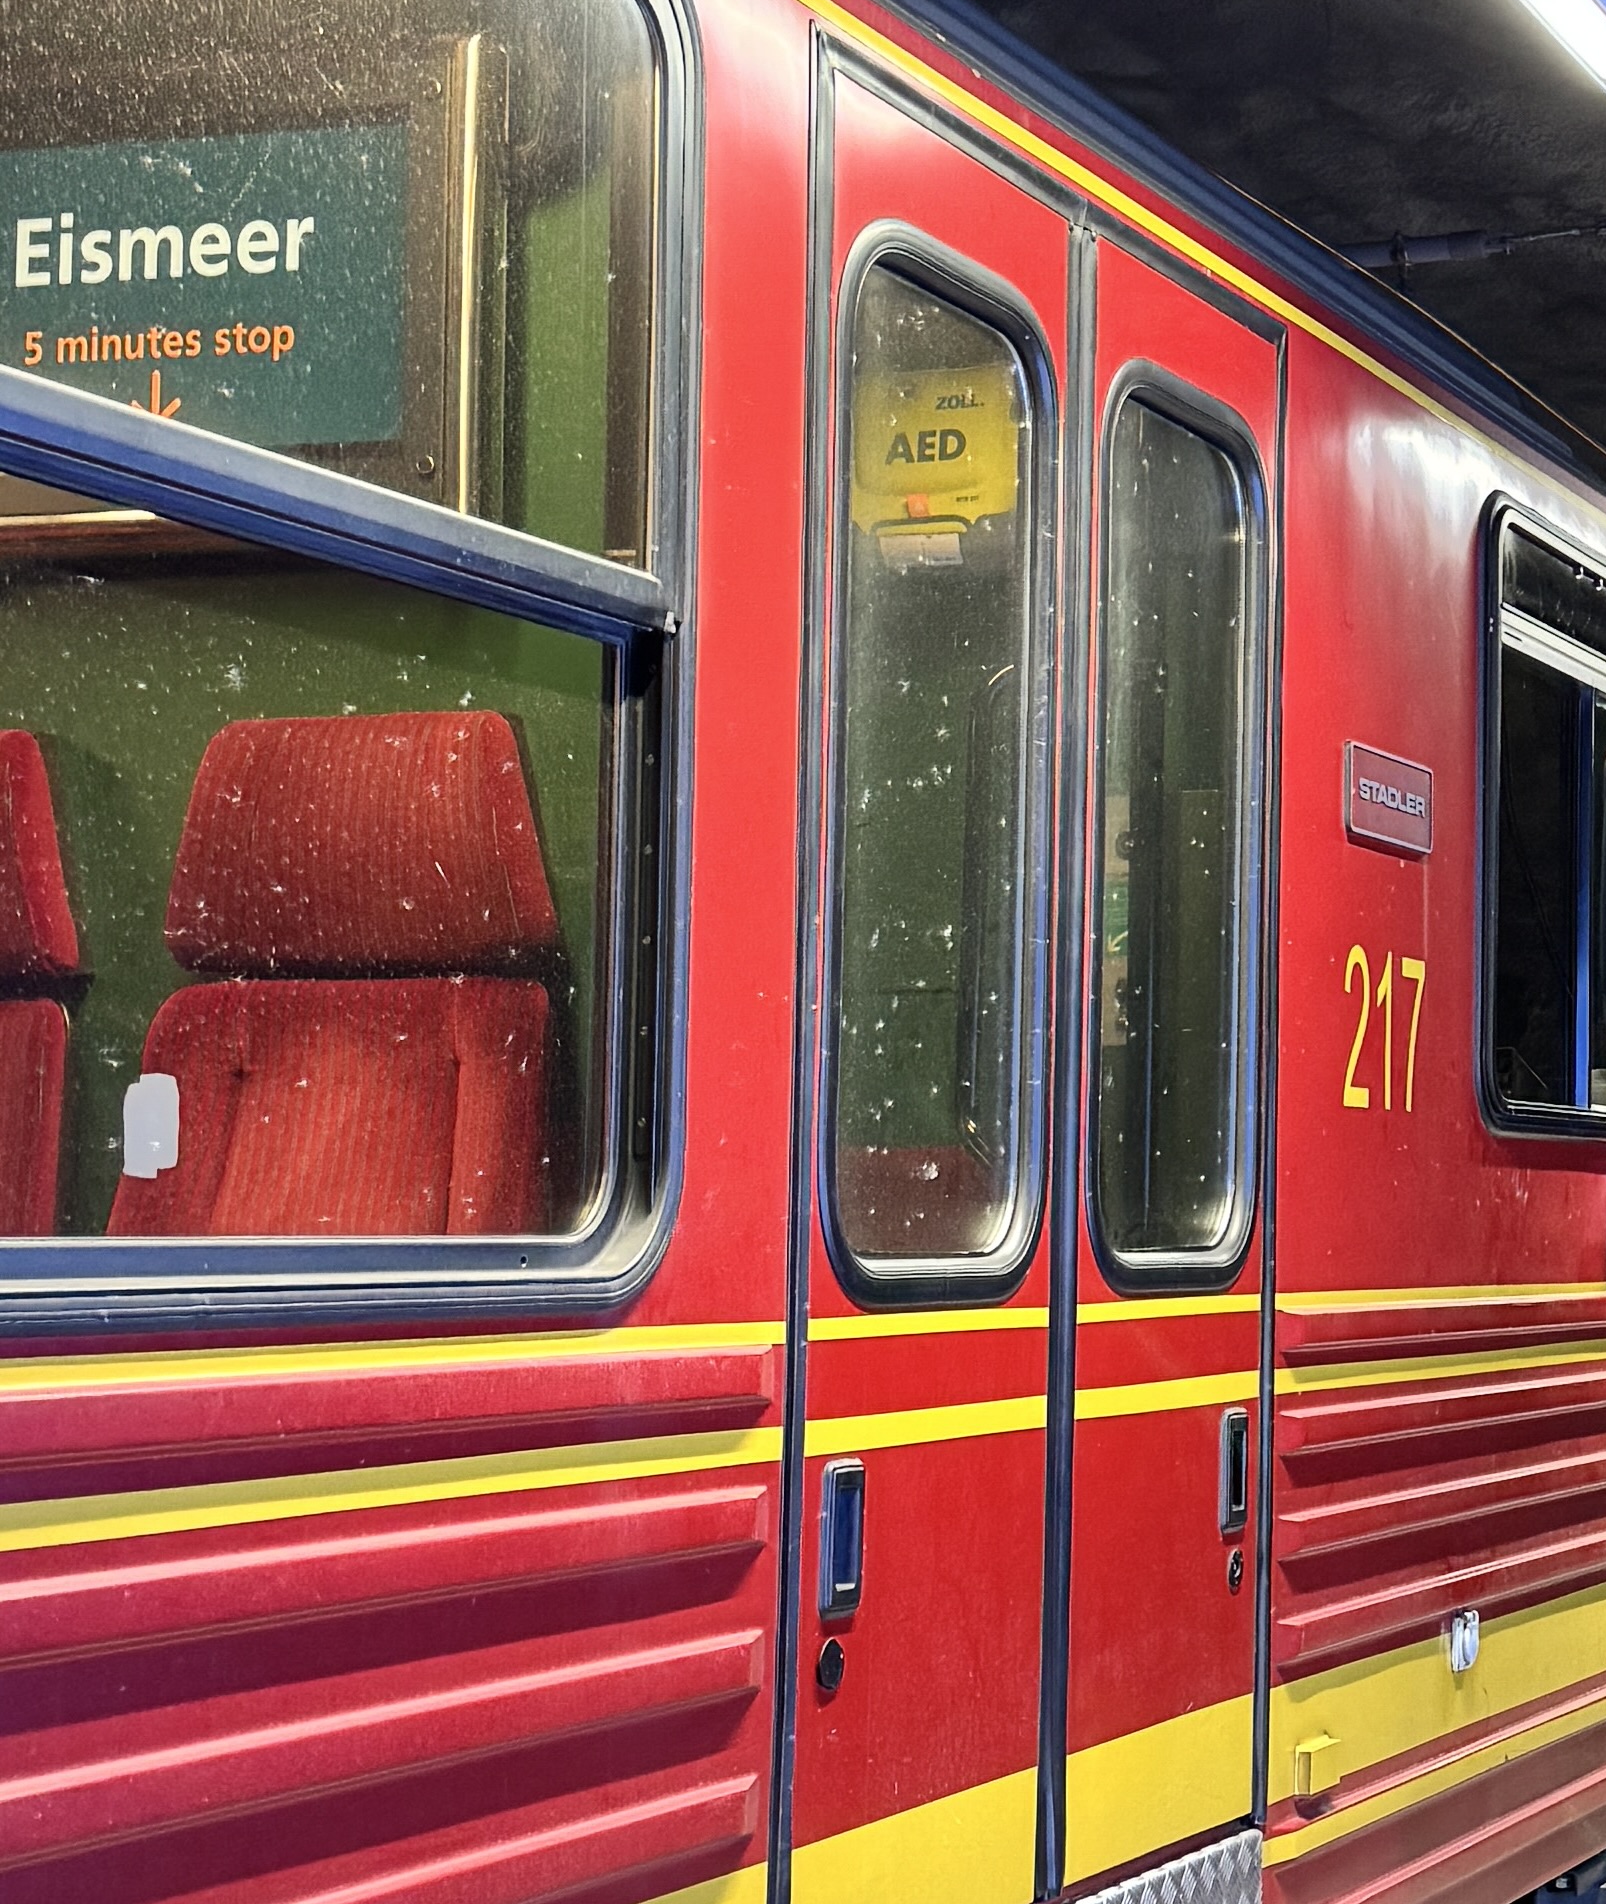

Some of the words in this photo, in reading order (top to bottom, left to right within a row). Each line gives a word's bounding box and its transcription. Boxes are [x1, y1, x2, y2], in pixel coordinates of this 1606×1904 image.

[16, 212, 315, 288] Eismeer
[24, 331, 43, 366] 5
[56, 326, 201, 364] minutes
[214, 322, 295, 362] stop
[885, 428, 967, 466] AED
[1359, 777, 1426, 819] STADLER
[1342, 944, 1426, 1113] 217
